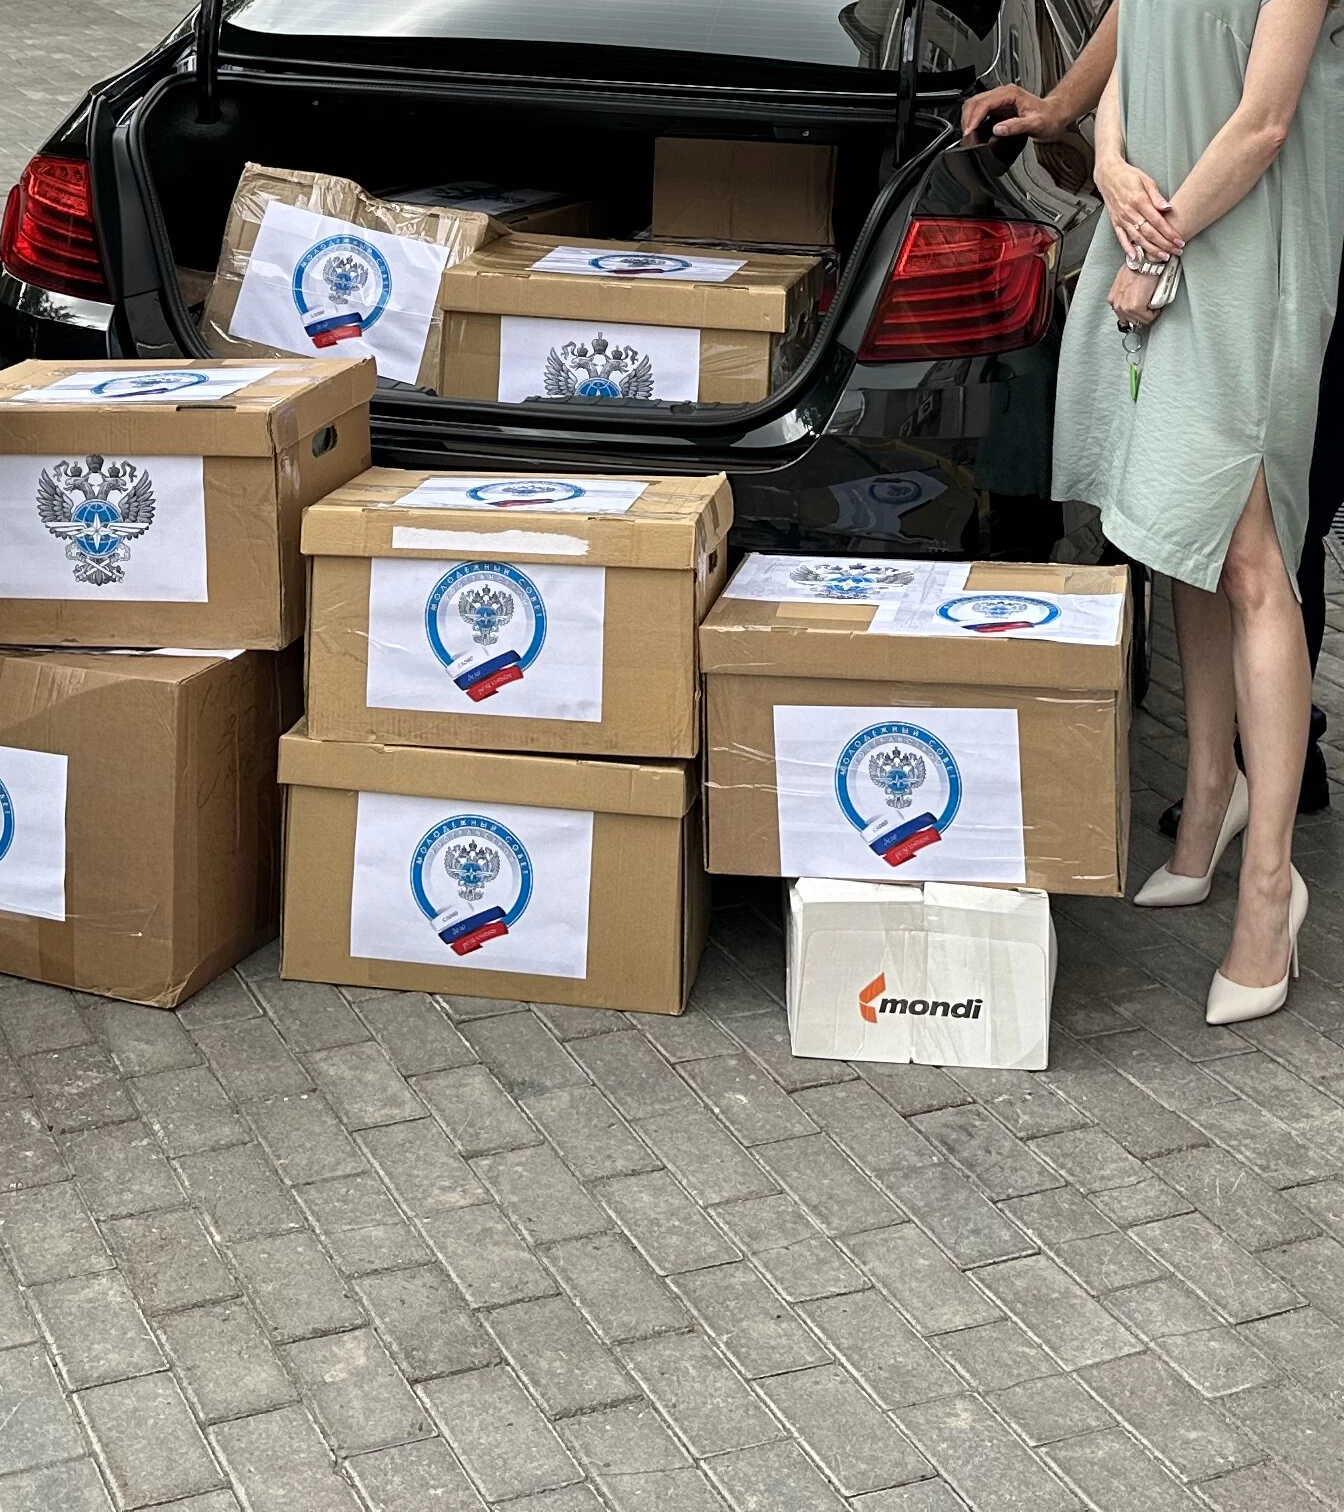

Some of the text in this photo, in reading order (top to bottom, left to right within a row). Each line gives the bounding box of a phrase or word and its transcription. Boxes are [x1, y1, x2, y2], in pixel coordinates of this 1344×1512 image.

[516, 576, 543, 619] СОВЕТ
[926, 737, 956, 779] СОВЕТ
[503, 833, 528, 875] СОВЕТ
[879, 997, 983, 1019] mondi
